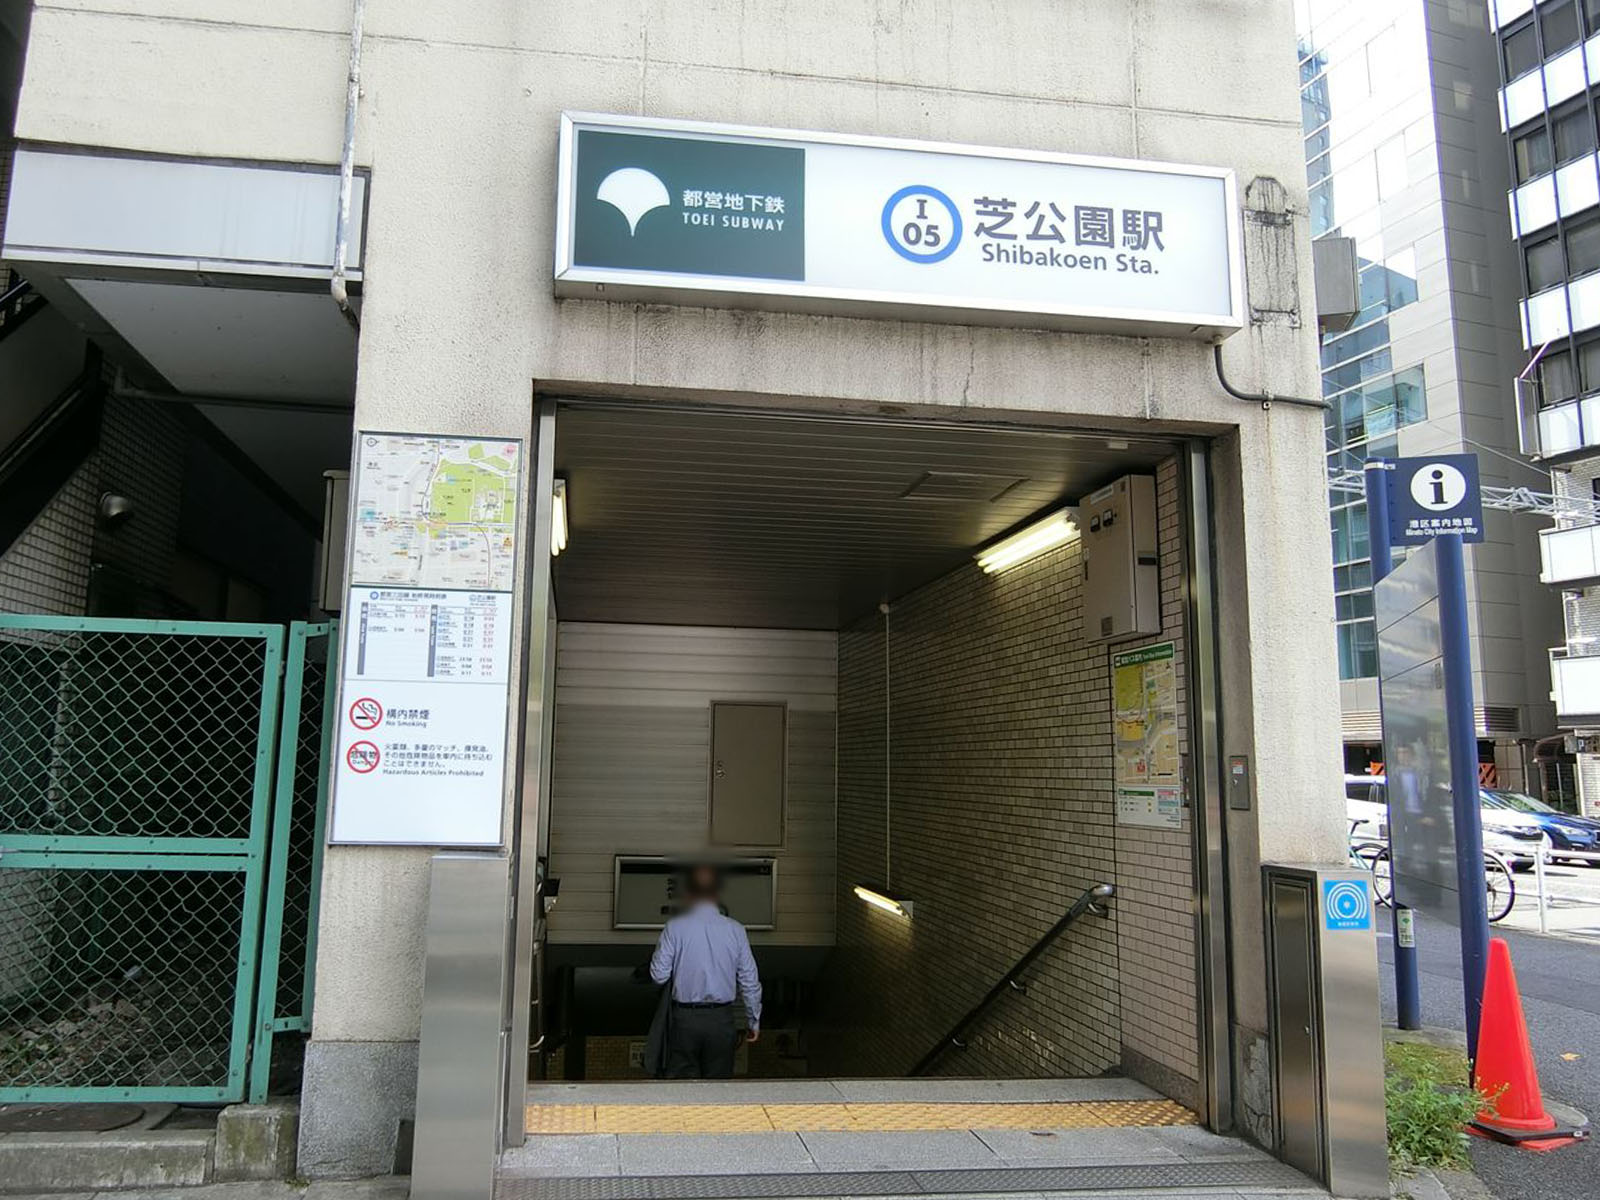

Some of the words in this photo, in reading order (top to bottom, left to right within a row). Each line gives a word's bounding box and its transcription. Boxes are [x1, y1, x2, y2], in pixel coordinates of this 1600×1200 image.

[683, 189, 786, 215] 都営地下鉄
[682, 212, 716, 227] TOEI
[722, 215, 786, 232] SUBWAY
[903, 221, 942, 248] 05
[973, 195, 1167, 253] 芝公園駅
[982, 242, 1109, 272] Shibakoen
[1116, 253, 1160, 275] Sta.
[386, 708, 430, 721] 構内禁煙
[397, 720, 428, 729] Smoking
